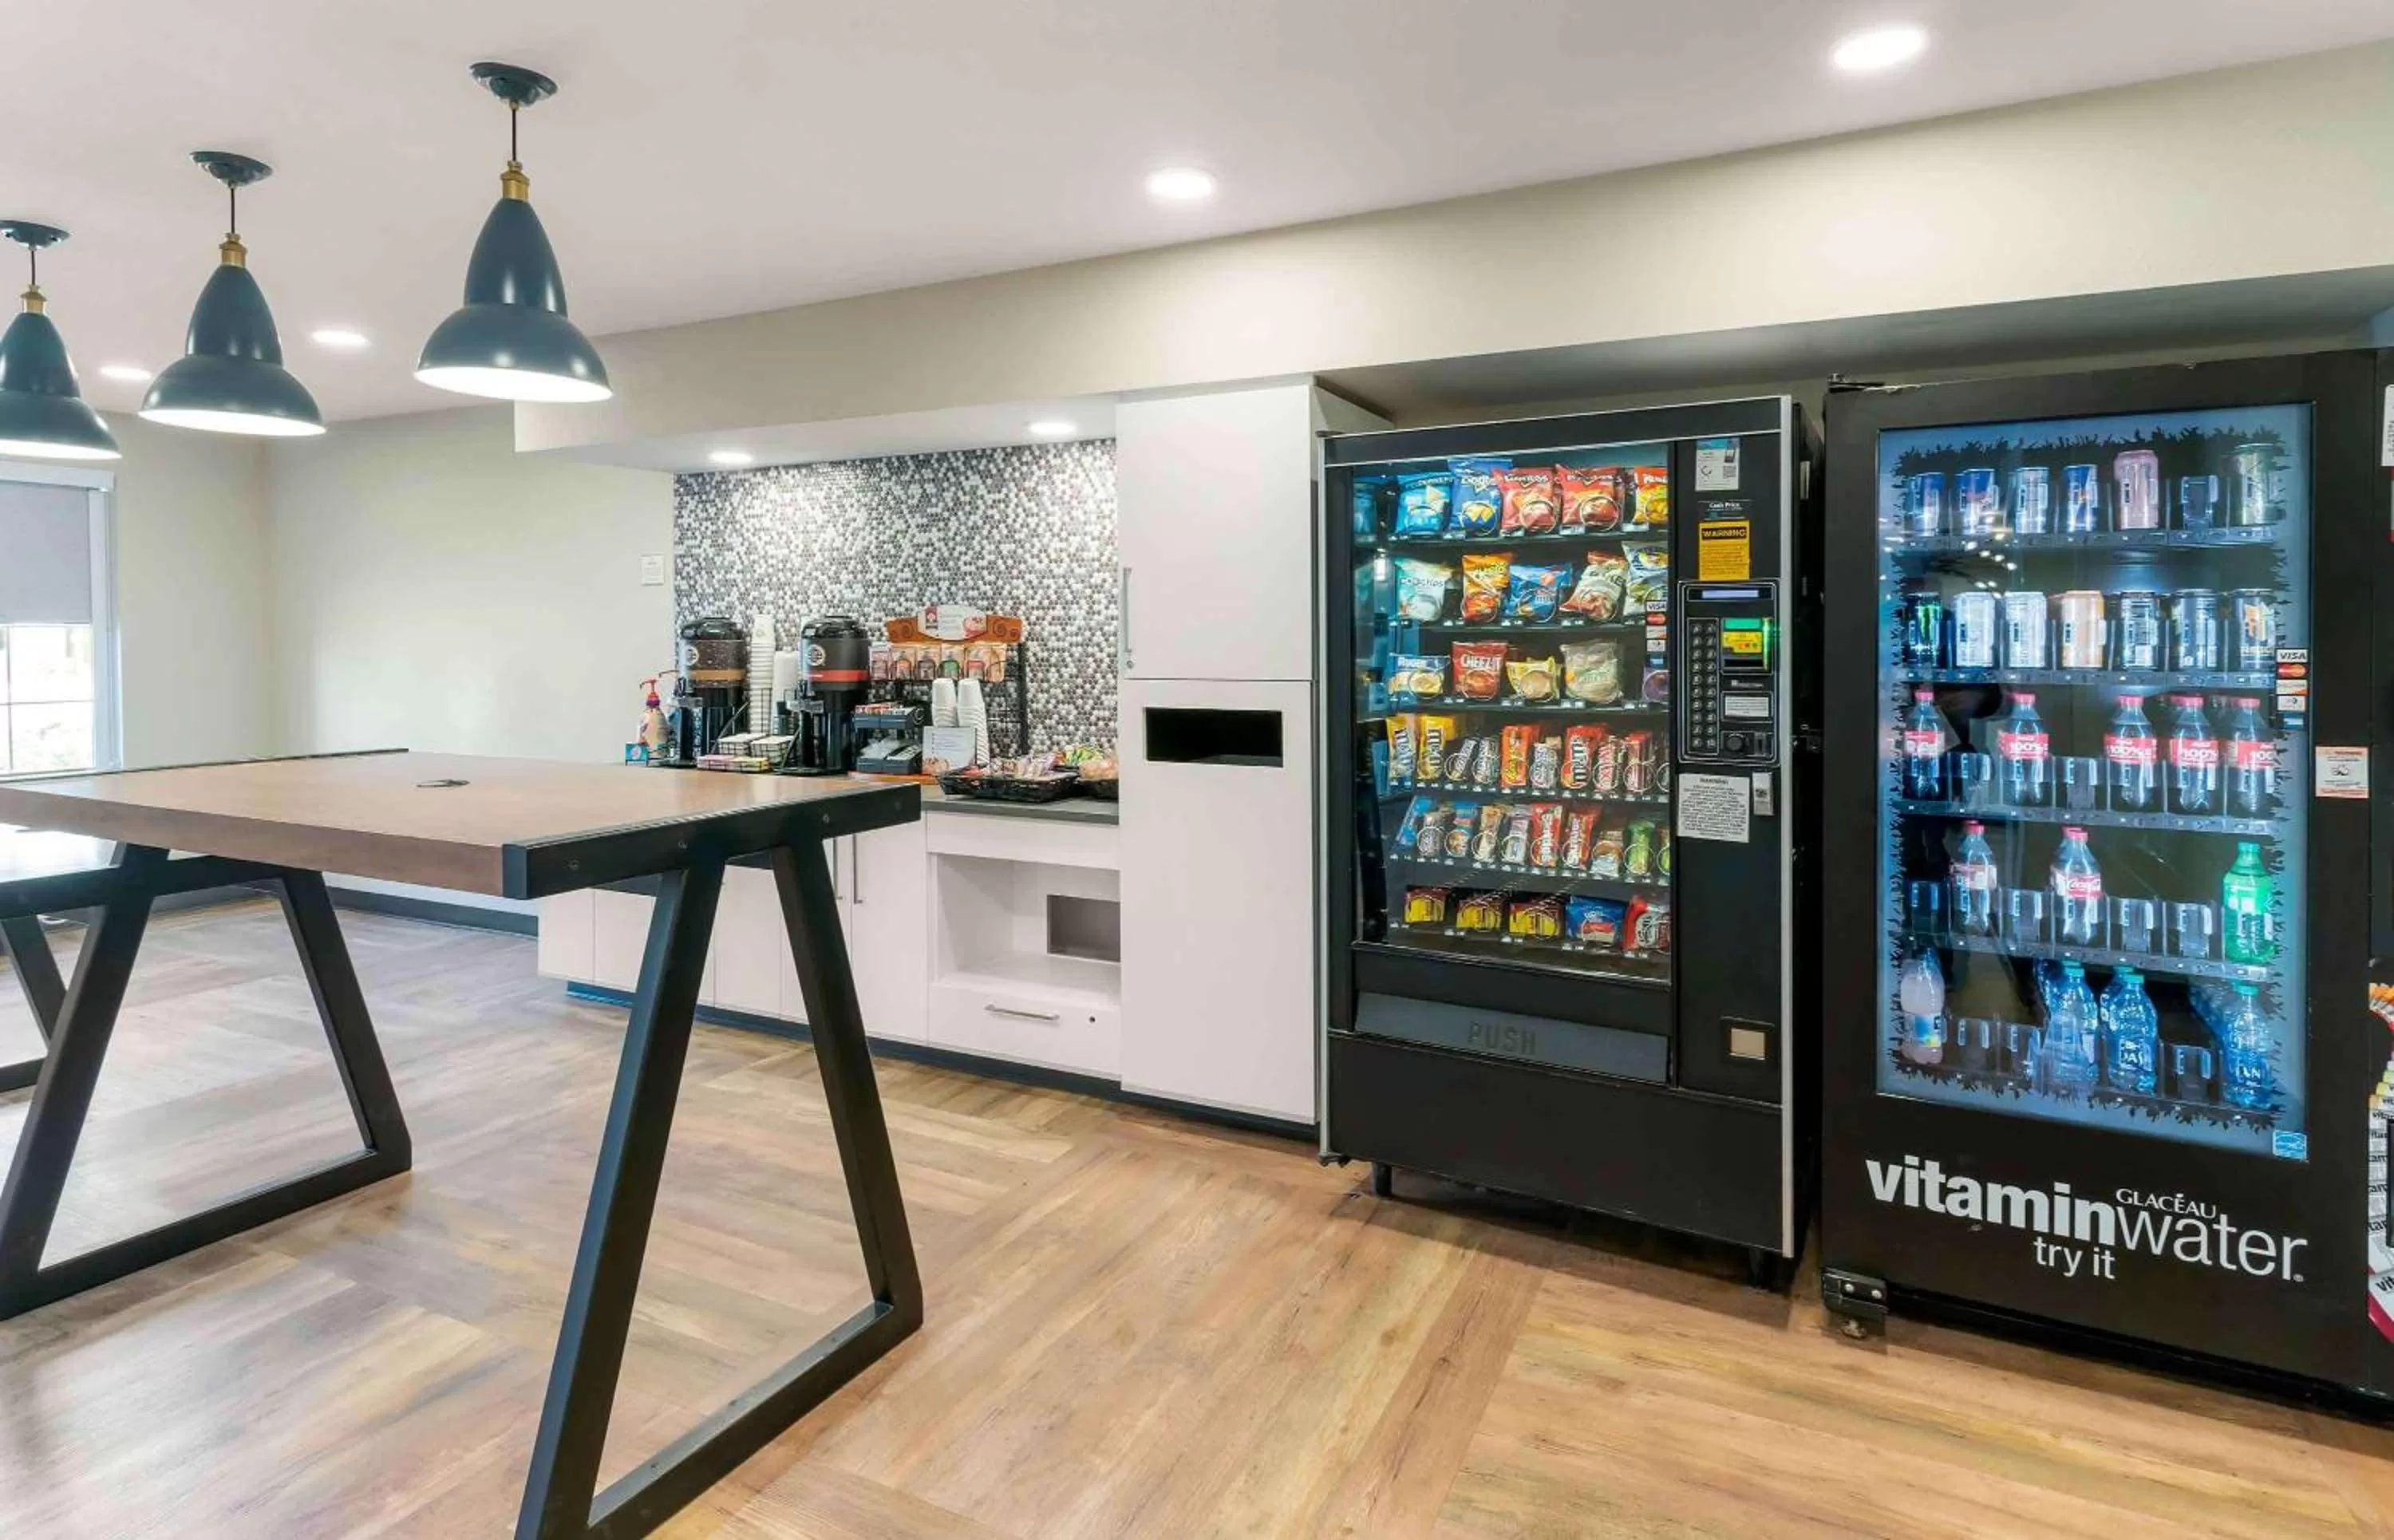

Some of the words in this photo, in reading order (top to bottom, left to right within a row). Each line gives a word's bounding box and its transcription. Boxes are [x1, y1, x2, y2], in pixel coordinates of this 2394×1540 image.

[1702, 528, 1746, 538] WARNING
[1468, 1021, 1536, 1055] PUSH
[2115, 1187, 2216, 1219] GLACÉAU
[2033, 1236, 2083, 1277] try
[2093, 1246, 2115, 1279] it
